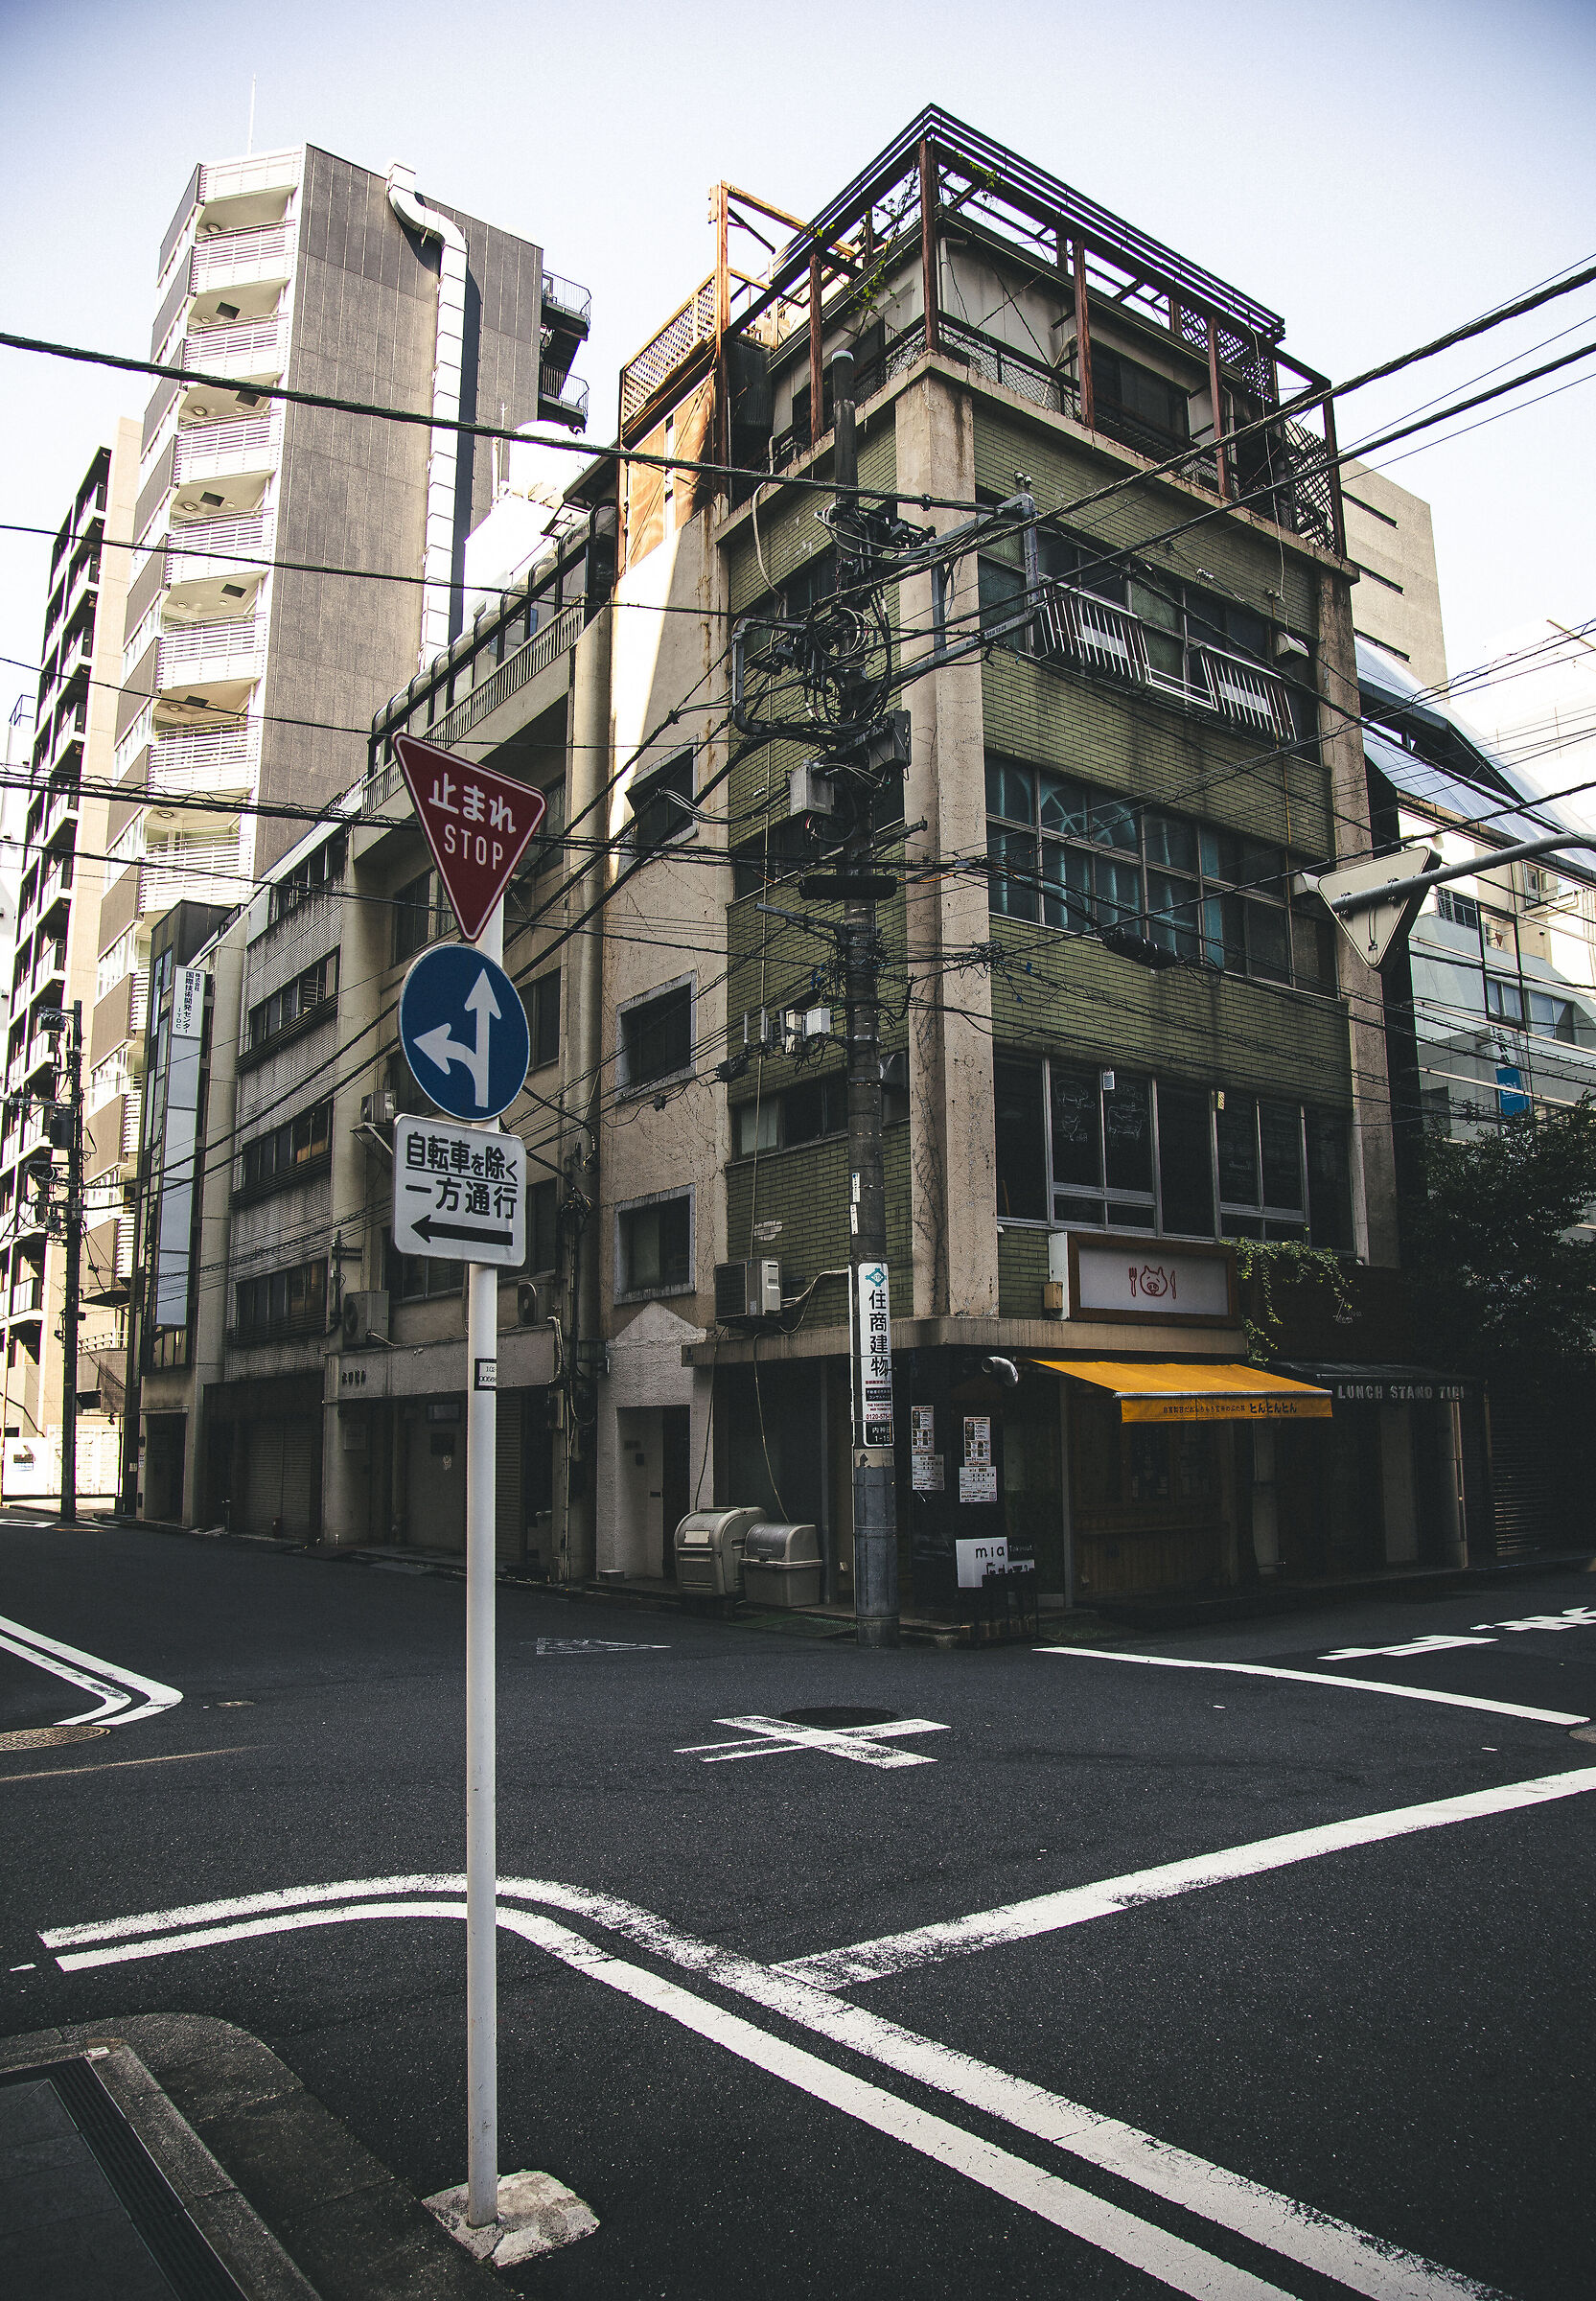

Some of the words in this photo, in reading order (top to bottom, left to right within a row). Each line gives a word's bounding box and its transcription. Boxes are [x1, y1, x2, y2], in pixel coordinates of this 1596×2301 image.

[428, 773, 517, 833] 止まれ
[444, 824, 503, 870] STOP
[406, 1131, 518, 1182] 自転車を除く
[405, 1176, 518, 1220] 一方通行
[868, 1290, 889, 1377] 住商建物
[1249, 1403, 1297, 1414] とんとんとん
[1338, 1385, 1383, 1399] LUNCH
[1390, 1385, 1432, 1399] STAND
[975, 1546, 1005, 1559] mia
